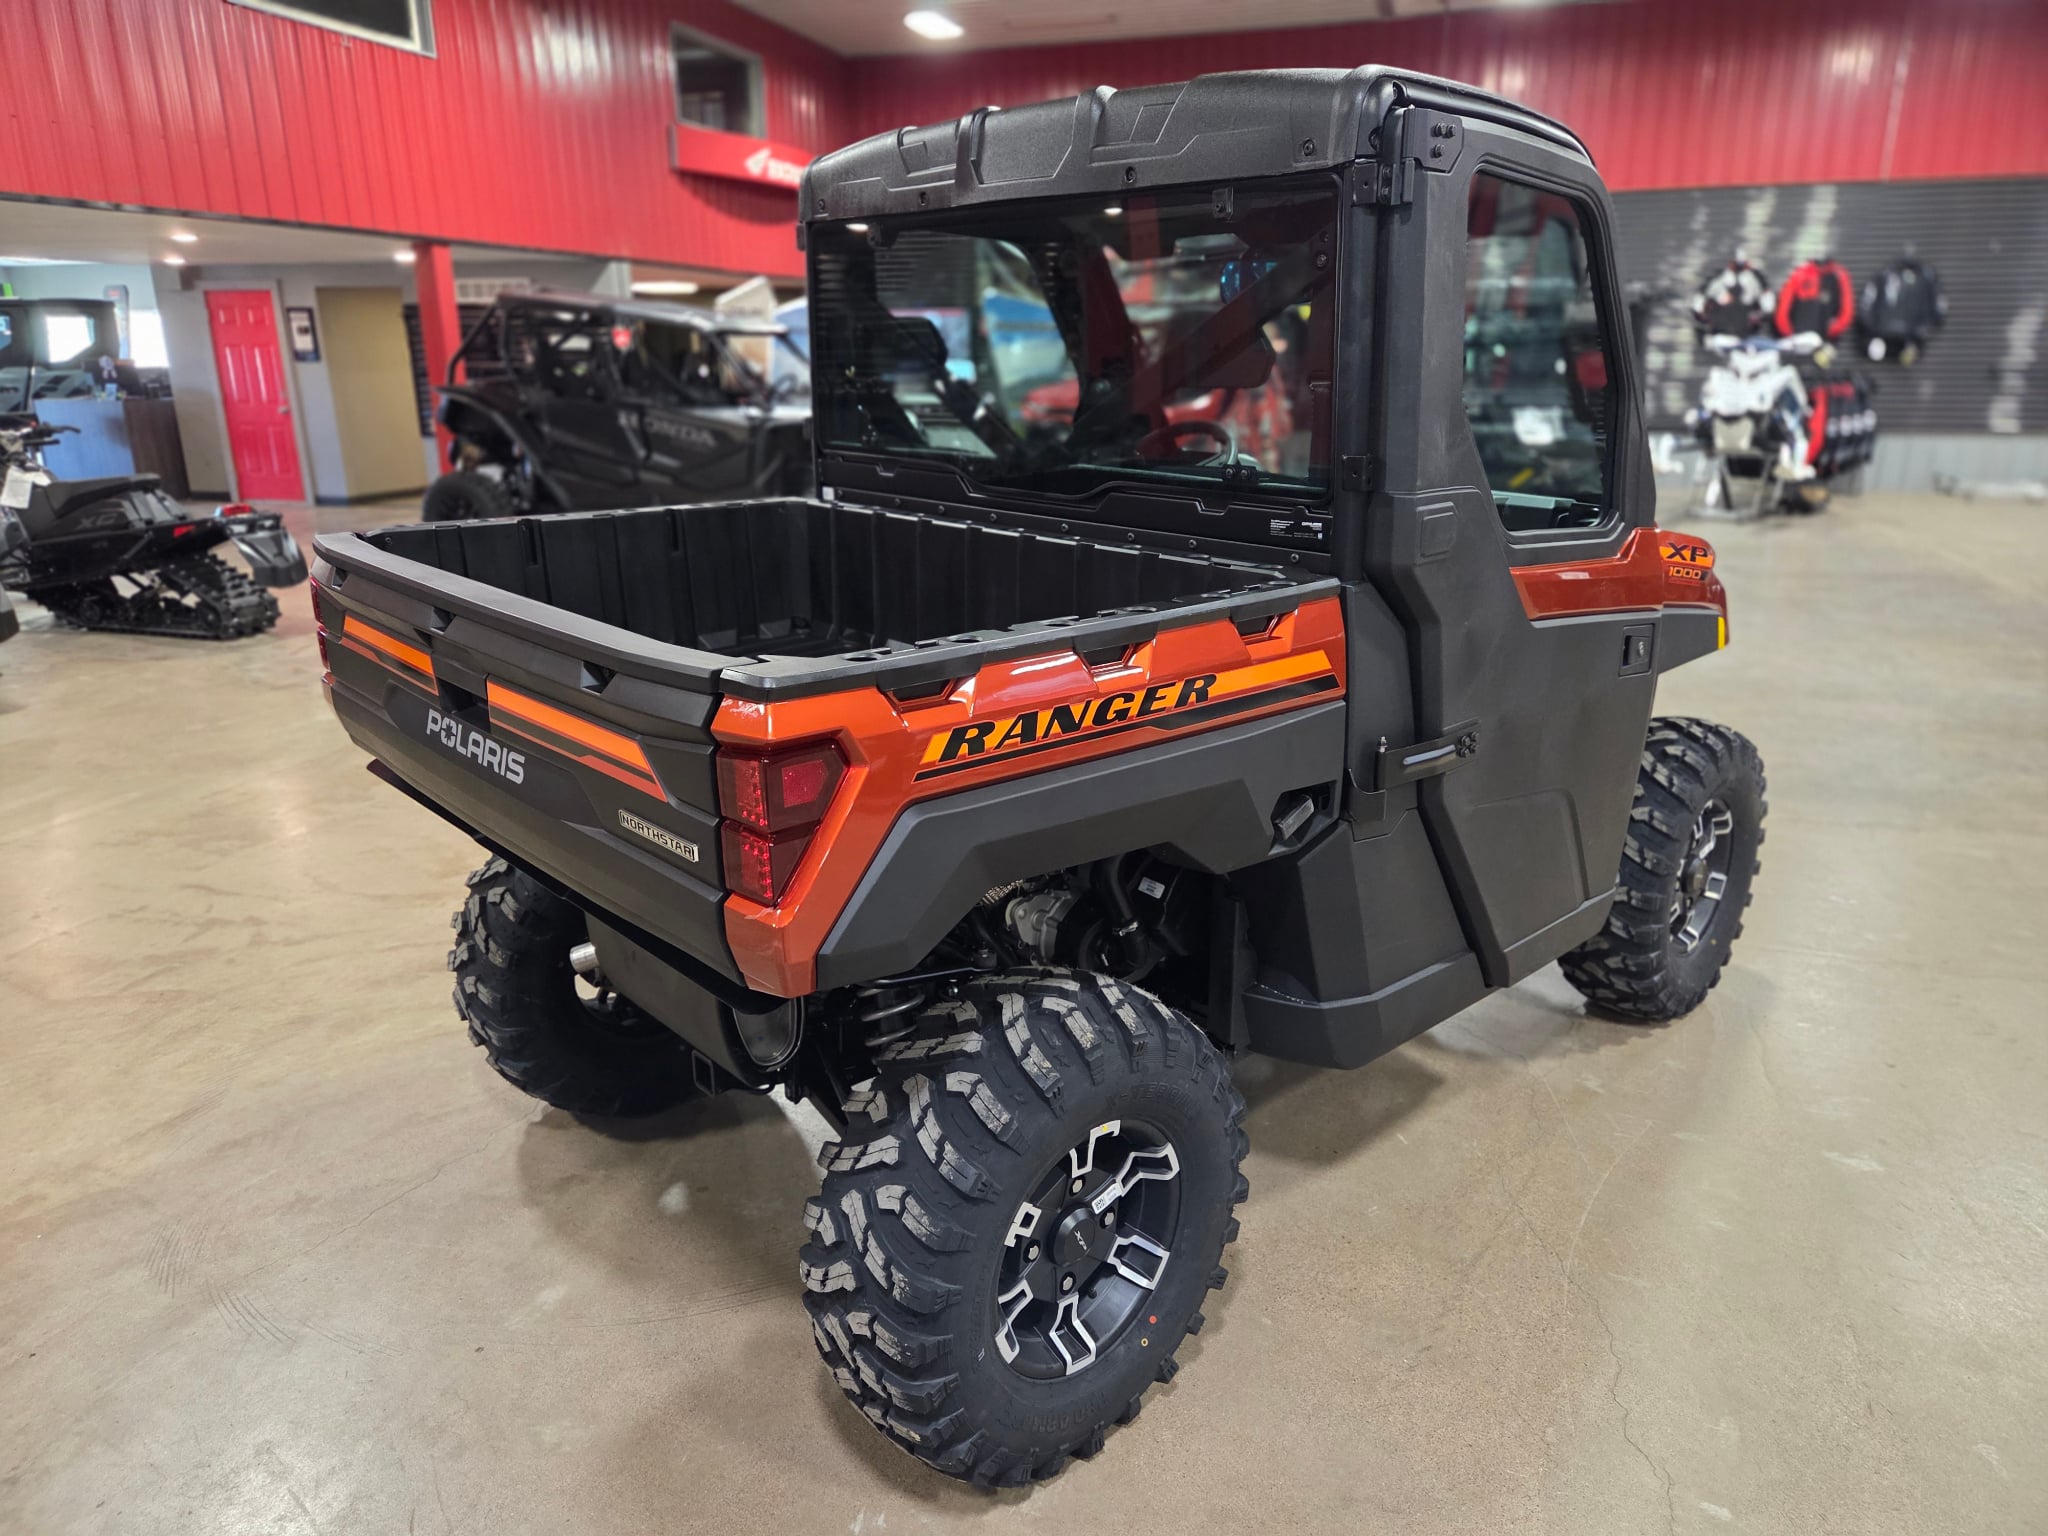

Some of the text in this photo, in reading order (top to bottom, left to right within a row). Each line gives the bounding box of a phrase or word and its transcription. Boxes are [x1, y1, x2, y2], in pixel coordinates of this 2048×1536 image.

[1665, 542, 1708, 562] XP
[1668, 566, 1702, 580] 1000
[938, 673, 1218, 763] RANGER
[426, 708, 526, 785] POLARIS
[621, 812, 694, 859] NORTHSTAR
